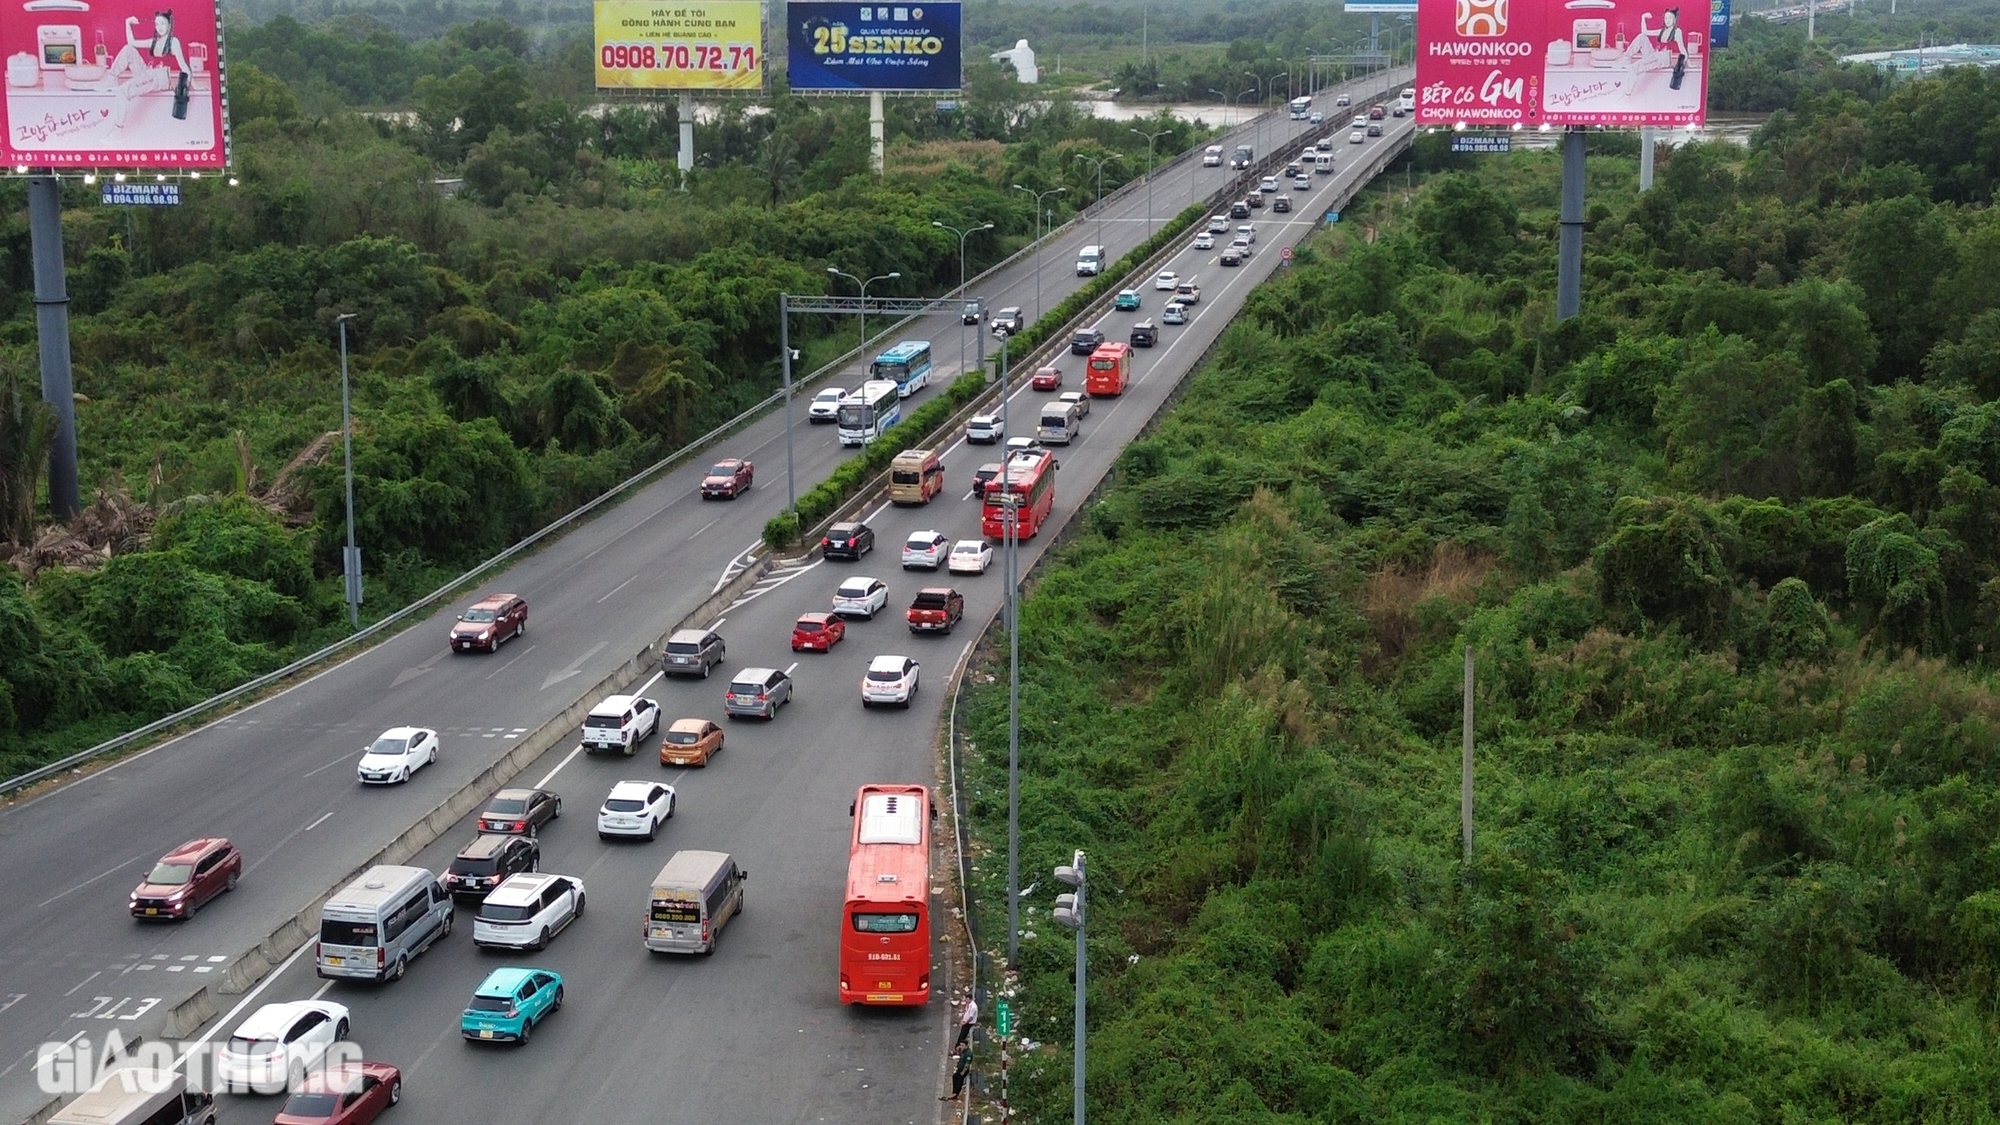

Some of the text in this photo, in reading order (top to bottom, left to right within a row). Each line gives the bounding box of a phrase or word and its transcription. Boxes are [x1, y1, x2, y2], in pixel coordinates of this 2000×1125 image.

[813, 26, 848, 54] 25
[848, 36, 942, 54] SENKO
[1429, 42, 1532, 56] HAWONKOO
[601, 45, 755, 70] 0908.70.72.71
[1421, 80, 1452, 105] BẾP
[1421, 108, 1522, 119] CHỌN HAWONKOO
[15, 109, 91, 142] 고맙습니다
[44, 153, 82, 161] TRANG
[88, 153, 110, 161] GIA
[116, 154, 147, 163] DỤNG
[184, 151, 218, 161] QUỐC
